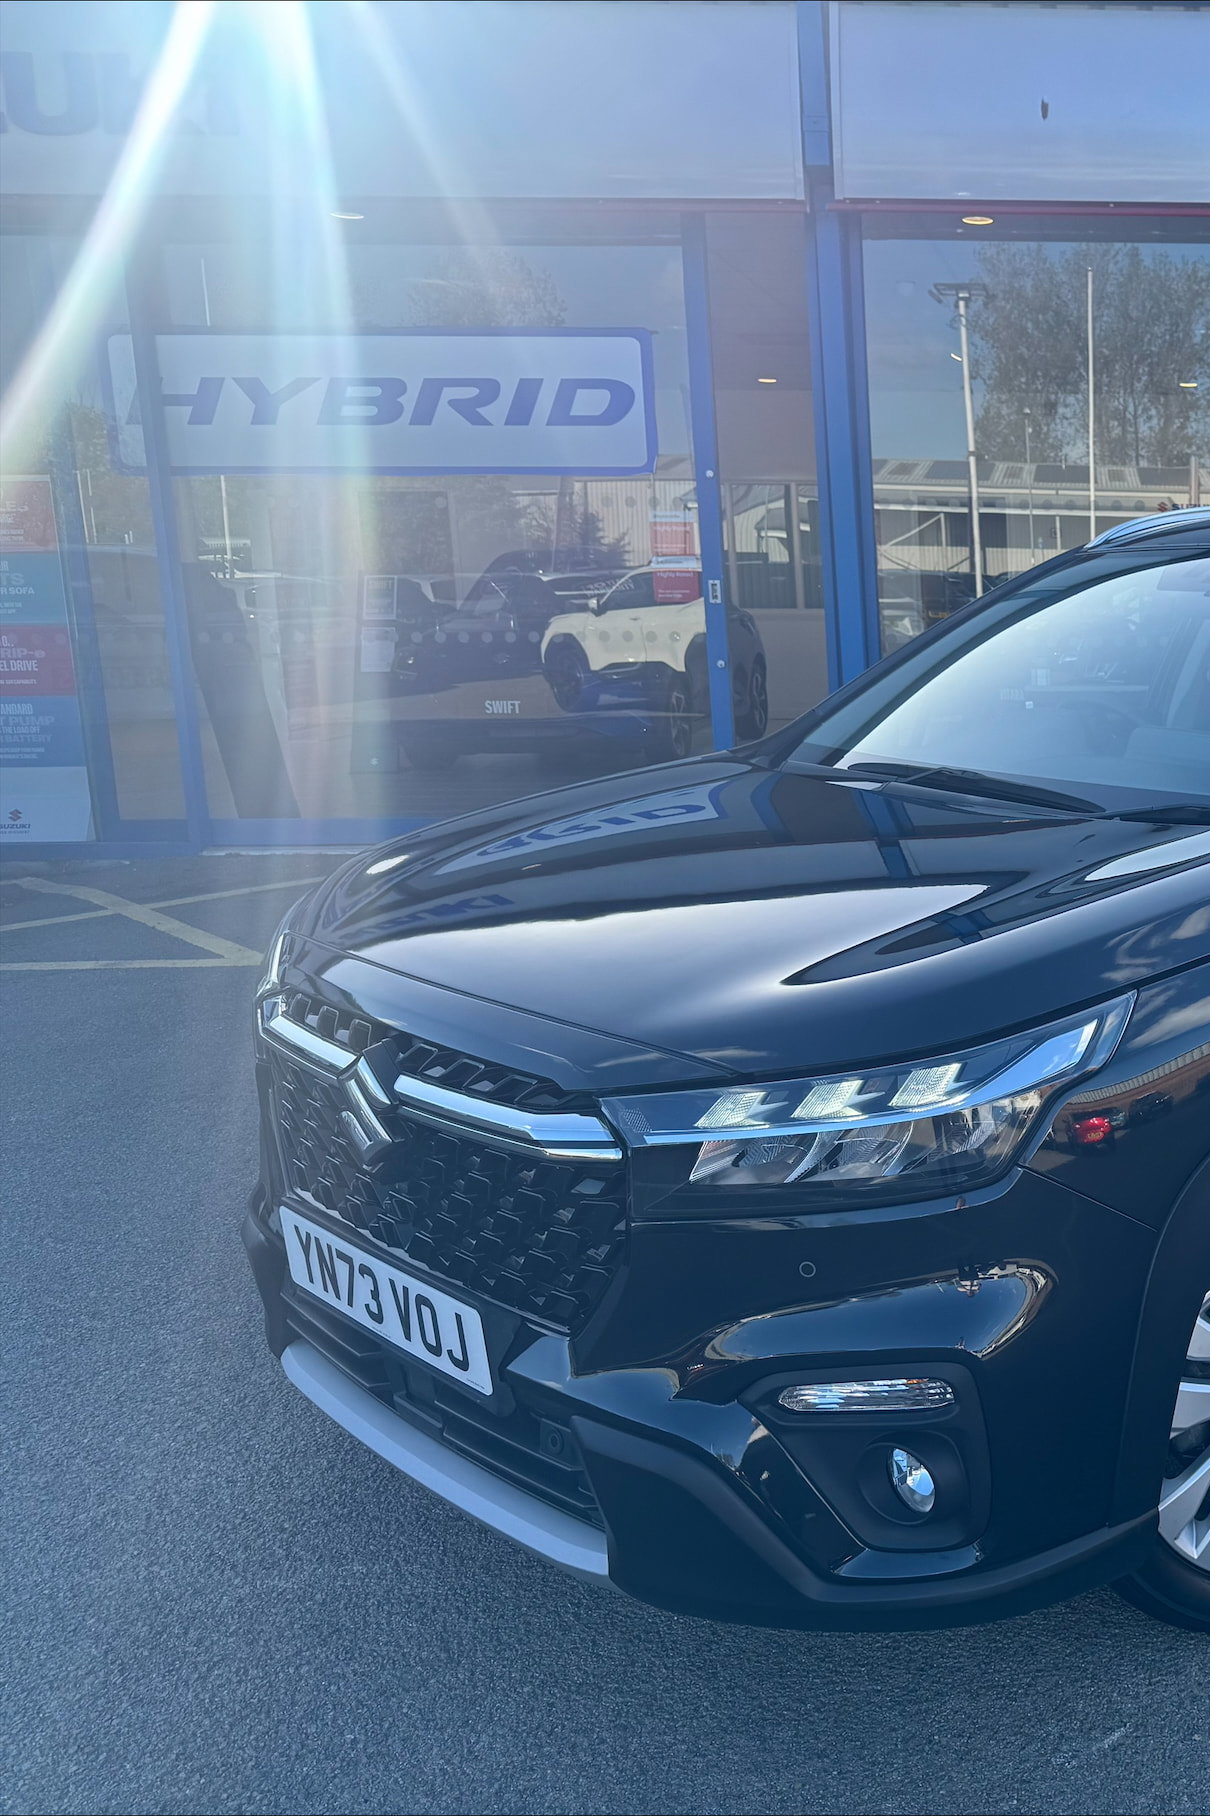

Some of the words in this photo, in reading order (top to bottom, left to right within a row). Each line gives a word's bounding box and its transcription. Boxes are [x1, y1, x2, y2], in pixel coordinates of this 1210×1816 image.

[0, 51, 241, 136] UKI
[126, 376, 636, 426] HYBRID
[10, 660, 39, 671] DRIVE
[484, 699, 521, 714] SWIFT
[294, 1224, 384, 1325] YN73
[388, 1277, 470, 1372] VOJ
